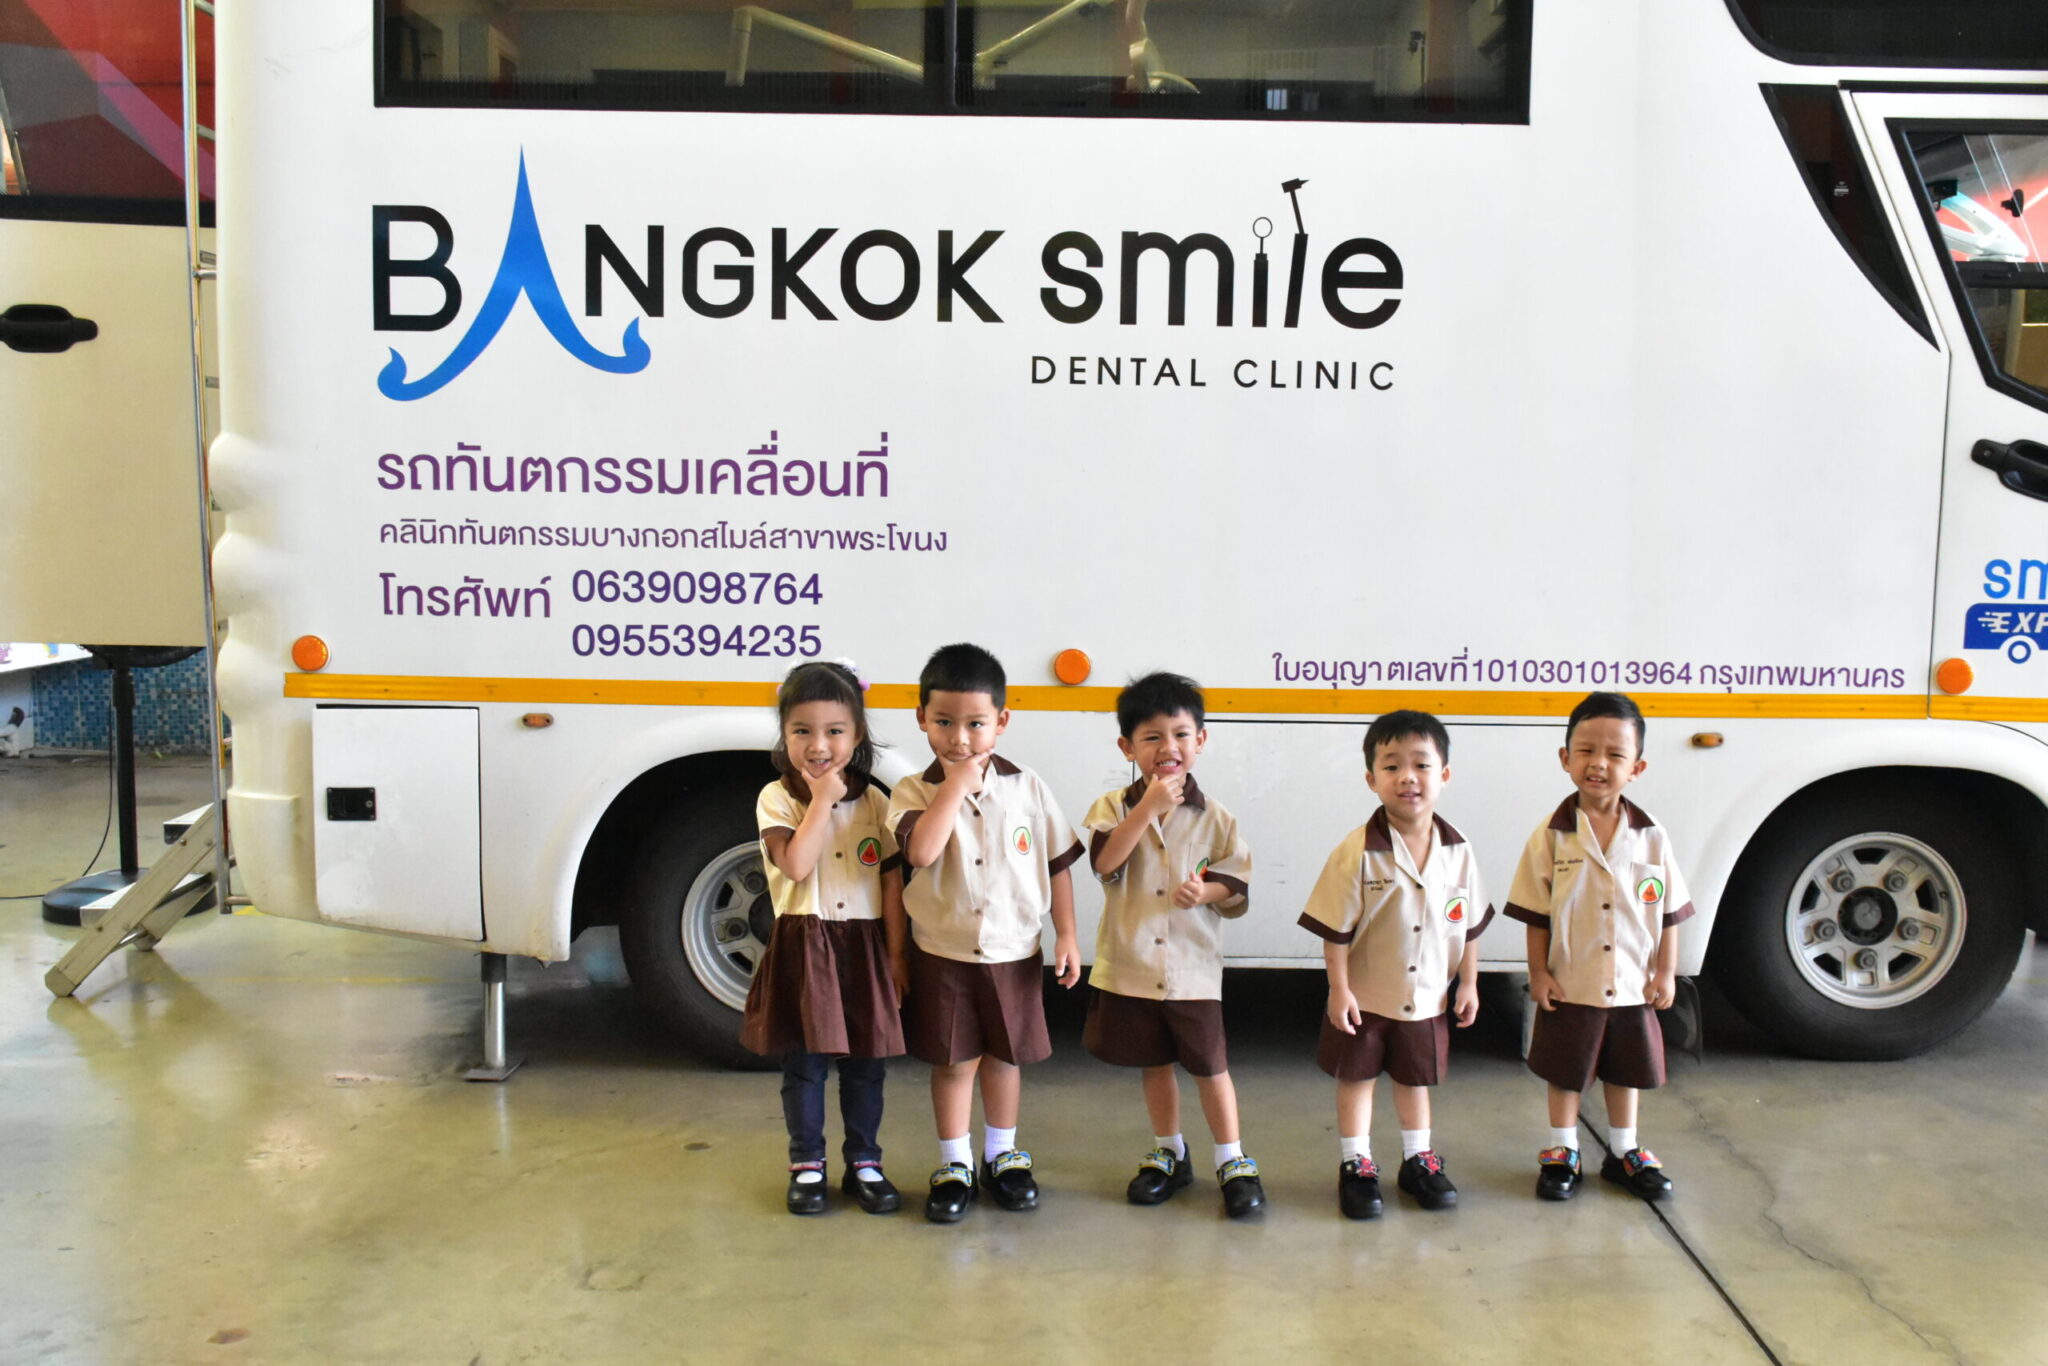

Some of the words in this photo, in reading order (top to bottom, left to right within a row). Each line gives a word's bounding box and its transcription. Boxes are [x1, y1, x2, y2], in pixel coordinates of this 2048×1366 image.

[372, 145, 1006, 402] BANGKOK
[1039, 177, 1405, 330] smile
[1031, 355, 1207, 388] DENTAL
[1233, 359, 1395, 391] CLINIC
[377, 430, 888, 498] รถทันตกรรมเคลื่อนที่
[380, 518, 948, 552] คลินิกทันตกรรมบางกอกสไมล์สาขาพระโขนง
[379, 572, 552, 618] โทรศัพท์
[572, 569, 824, 606] 0639098764
[572, 623, 822, 658] 0955394235
[1699, 663, 1906, 695] กรุงเทพมหานคร
